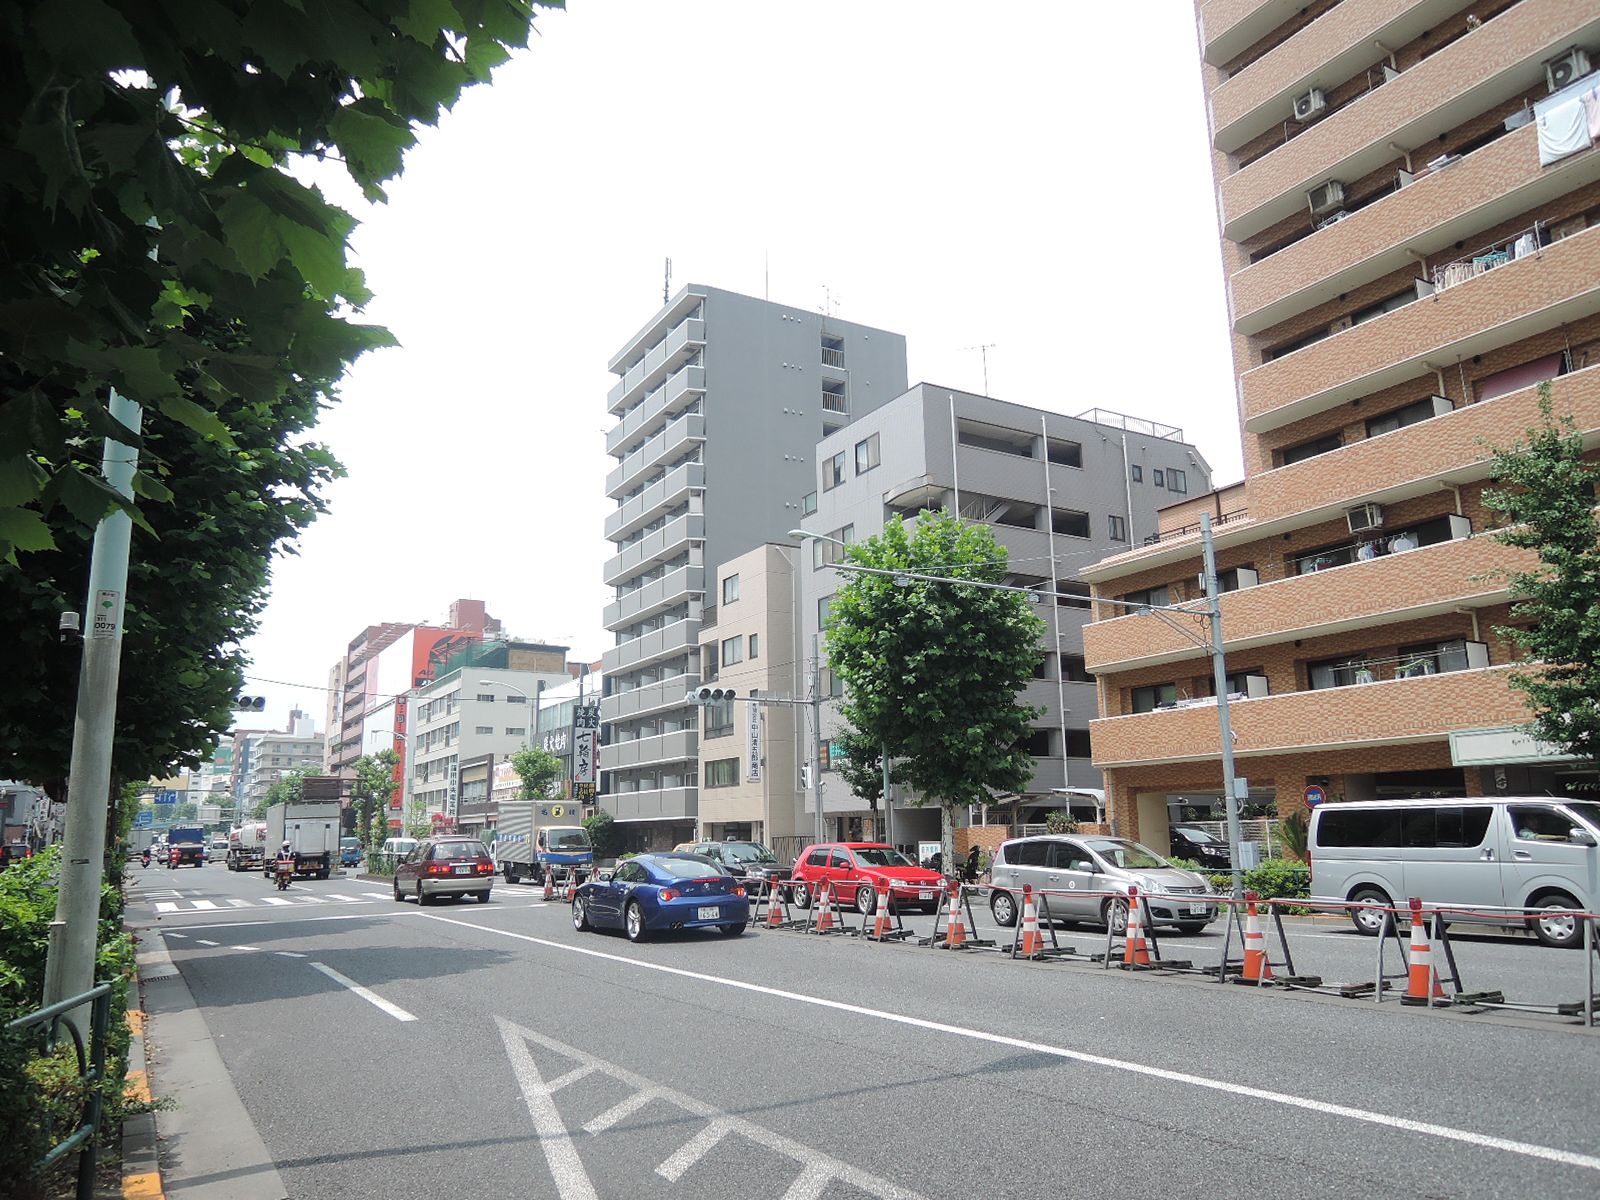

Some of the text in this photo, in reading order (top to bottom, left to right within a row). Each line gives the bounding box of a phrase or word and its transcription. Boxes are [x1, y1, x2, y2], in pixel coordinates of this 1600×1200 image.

[94, 622, 116, 630] 0079
[576, 731, 592, 776] 七輪房
